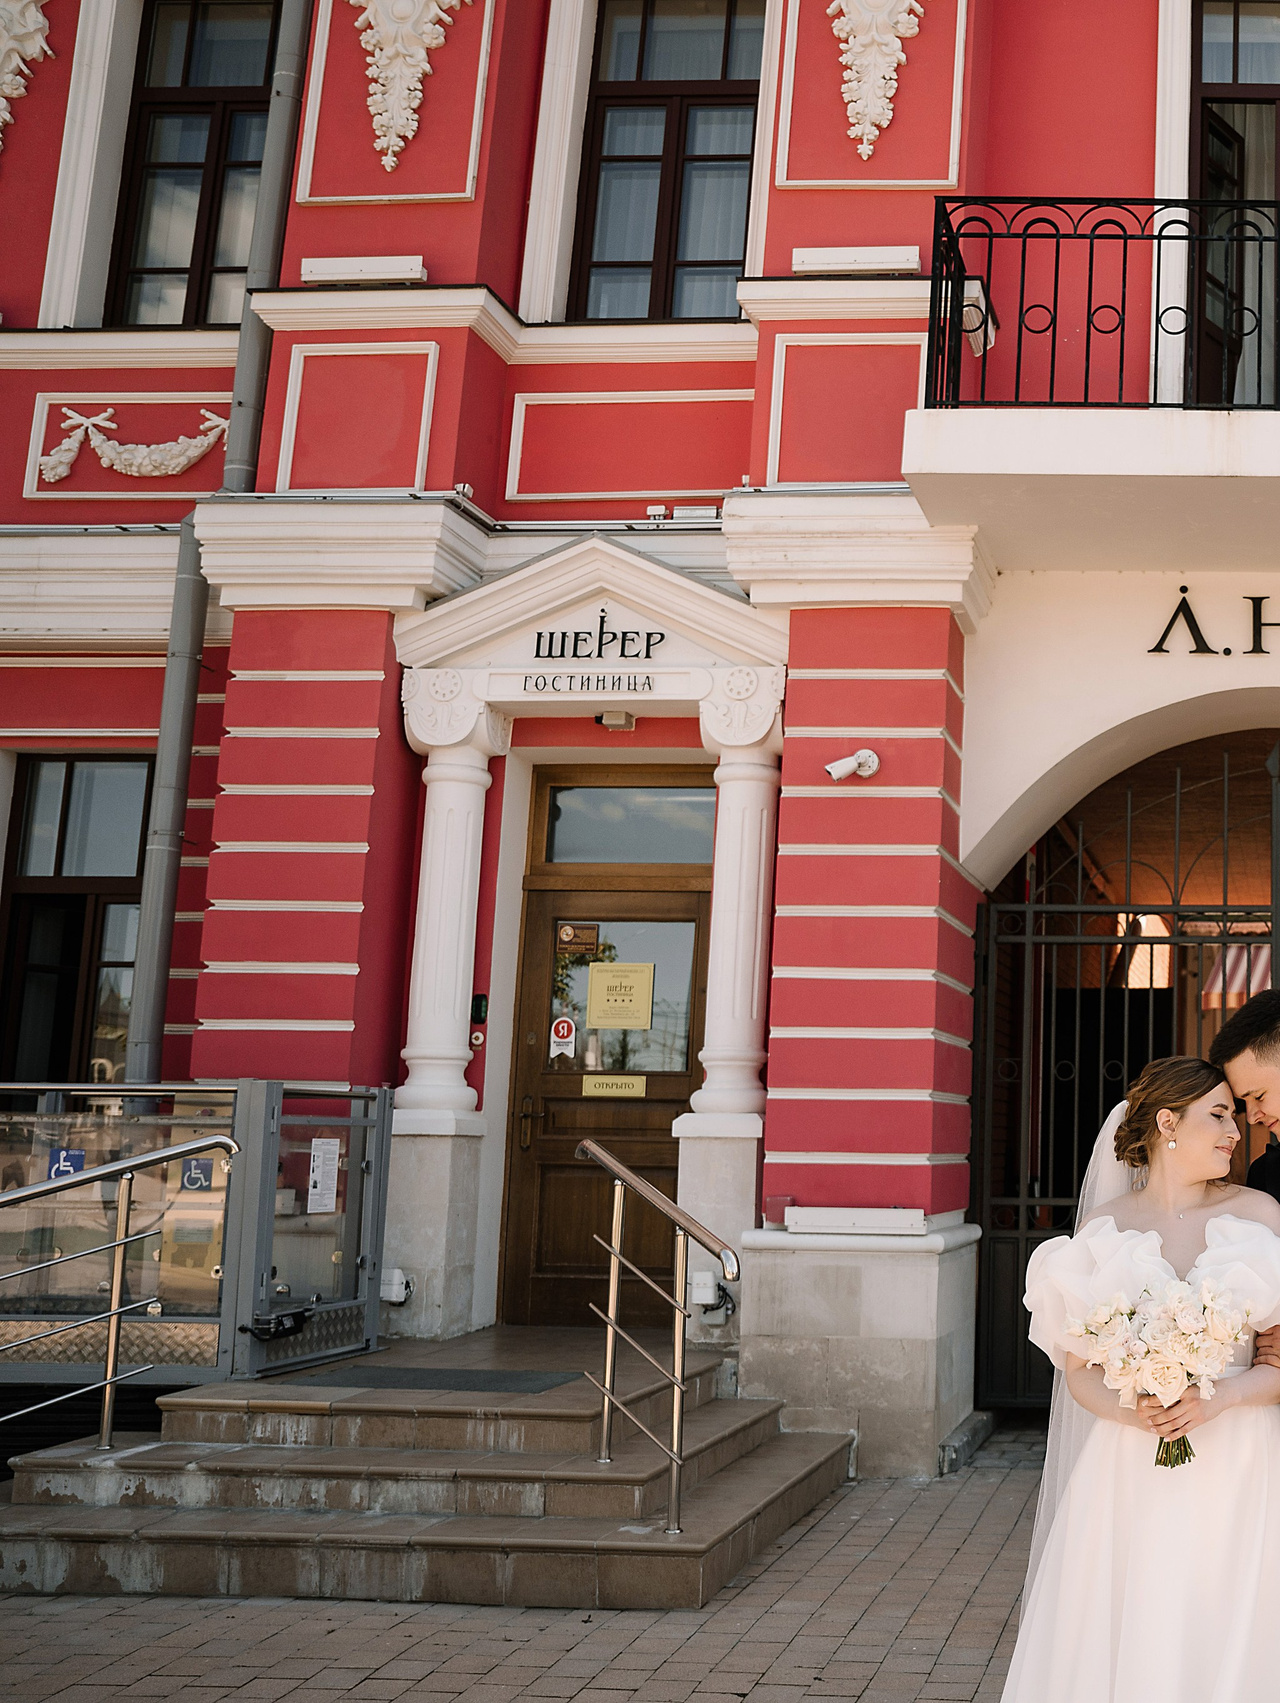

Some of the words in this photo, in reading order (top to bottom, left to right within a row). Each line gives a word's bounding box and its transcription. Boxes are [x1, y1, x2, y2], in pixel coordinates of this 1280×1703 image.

[533, 608, 666, 659] ШЕРЕР
[523, 675, 653, 692] ГОСТИНИЦА
[558, 1022, 568, 1037] Я
[593, 1081, 635, 1090] ОТКРЫТО
